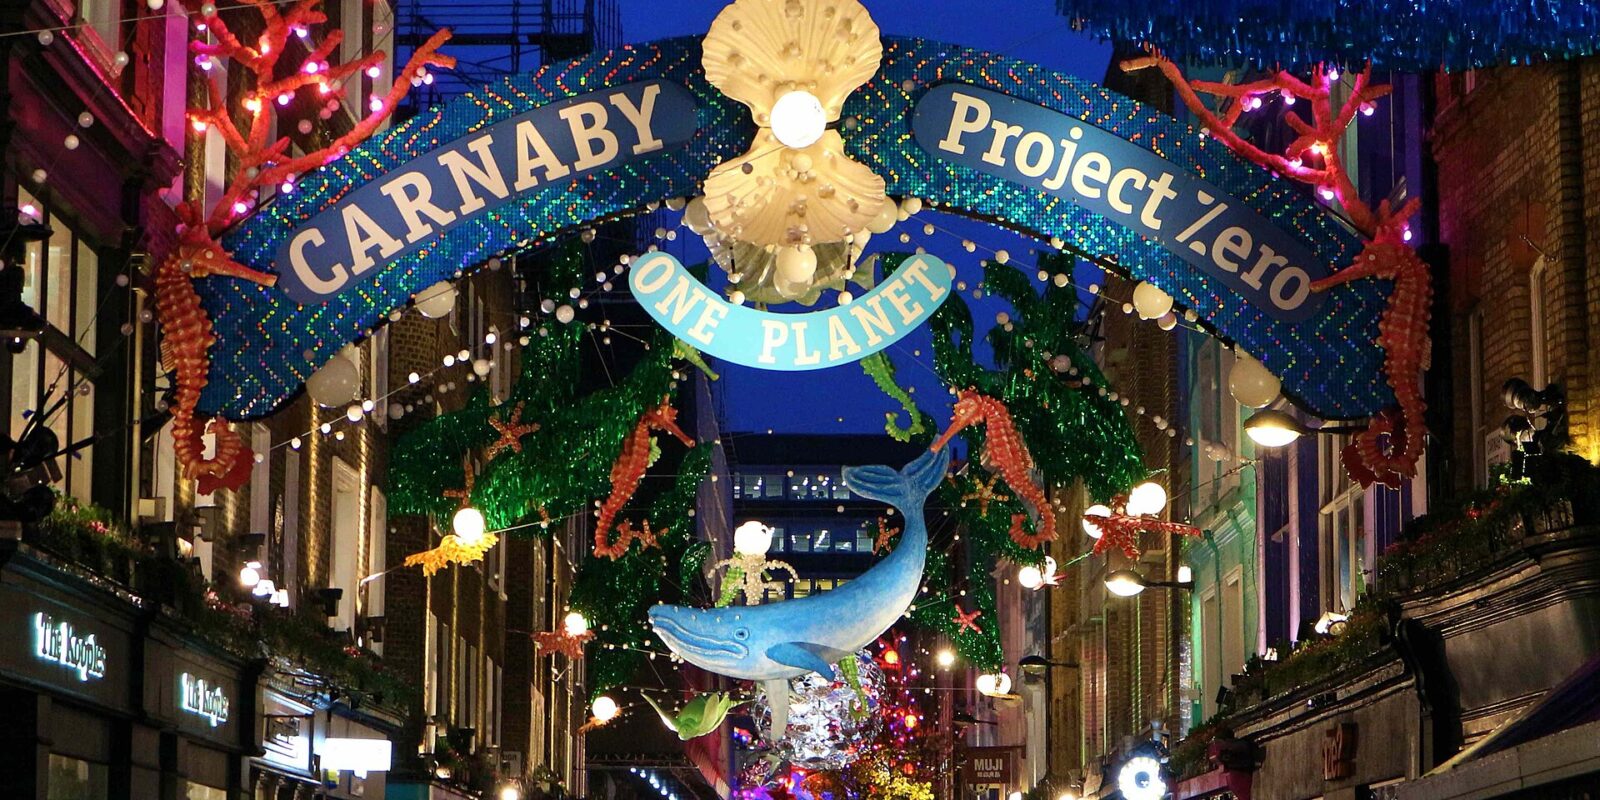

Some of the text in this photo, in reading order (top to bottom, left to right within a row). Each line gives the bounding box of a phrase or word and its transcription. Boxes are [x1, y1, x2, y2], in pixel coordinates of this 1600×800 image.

[289, 84, 663, 295] CARNABY
[938, 92, 1311, 310] Project Zero
[634, 256, 946, 365] ONE PLANET
[35, 612, 107, 682] The Kooples
[974, 758, 1003, 771] MUJI
